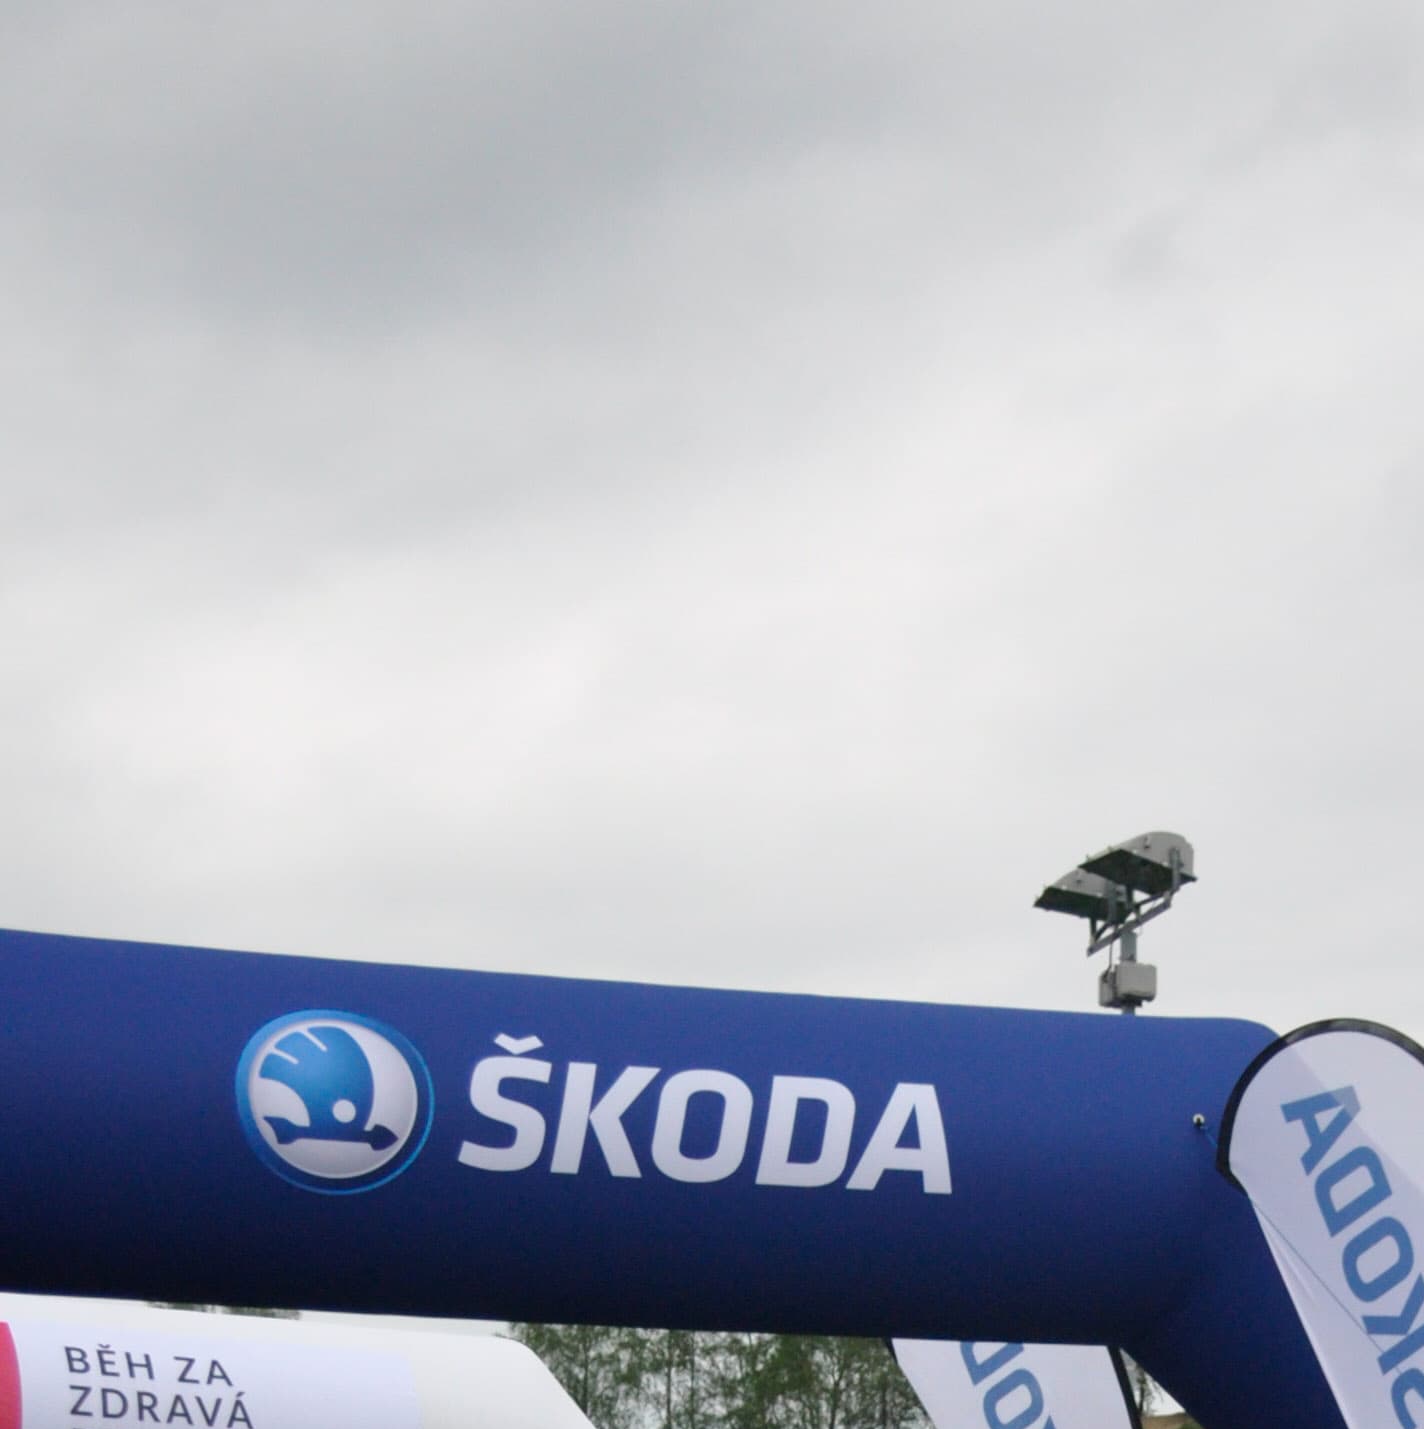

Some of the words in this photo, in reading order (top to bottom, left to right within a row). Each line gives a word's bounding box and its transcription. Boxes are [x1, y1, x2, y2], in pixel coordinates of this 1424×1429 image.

[458, 1034, 953, 1194] ŠKODA
[64, 1344, 155, 1380] BĚH
[173, 1356, 233, 1386] ZA
[69, 1385, 254, 1429] ZDRAVÁ
